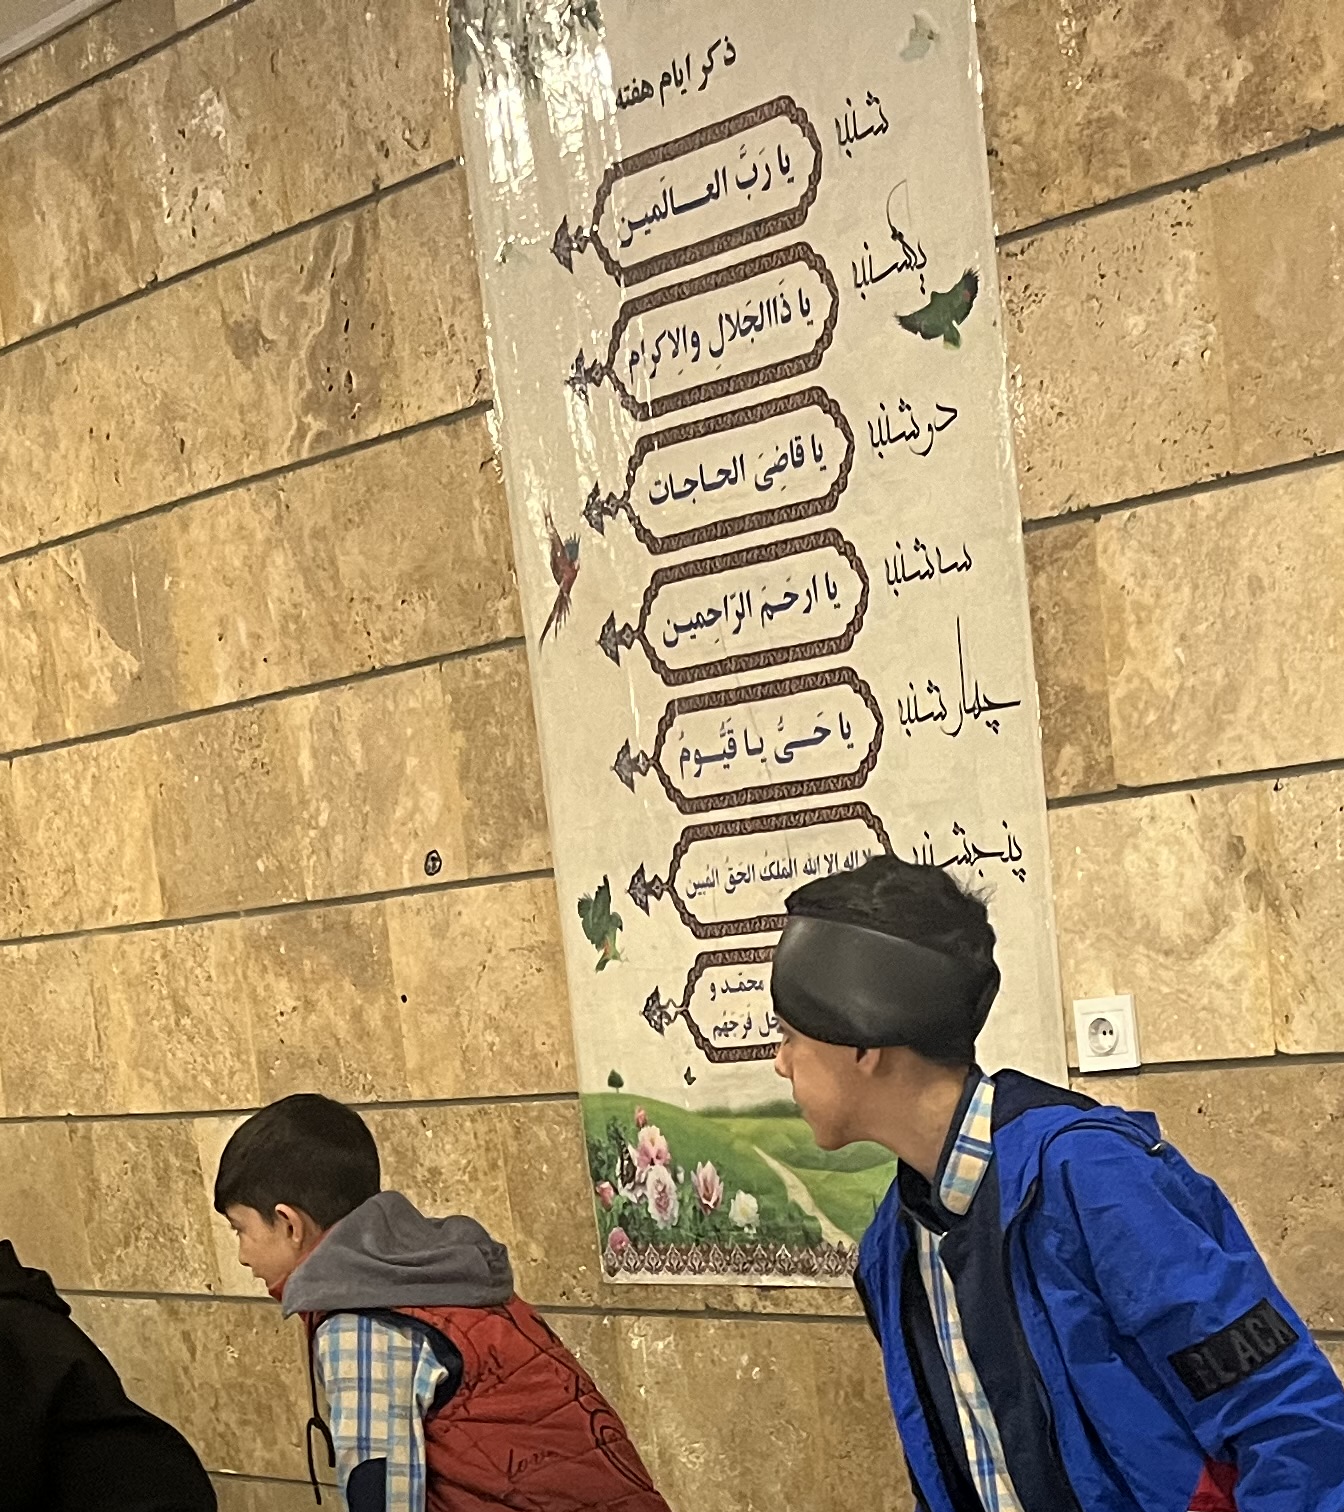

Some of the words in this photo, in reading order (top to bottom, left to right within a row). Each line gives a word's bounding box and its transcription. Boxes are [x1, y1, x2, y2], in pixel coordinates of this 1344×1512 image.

[659, 53, 692, 107] ایام
[698, 36, 737, 91] ذکر
[616, 78, 654, 109] هفته
[778, 144, 795, 183] یا
[799, 288, 814, 326] یا
[811, 434, 827, 471] یا
[649, 454, 745, 506] الحاجات
[825, 572, 840, 609] یا
[744, 727, 767, 763] یا
[839, 712, 854, 749] یا
